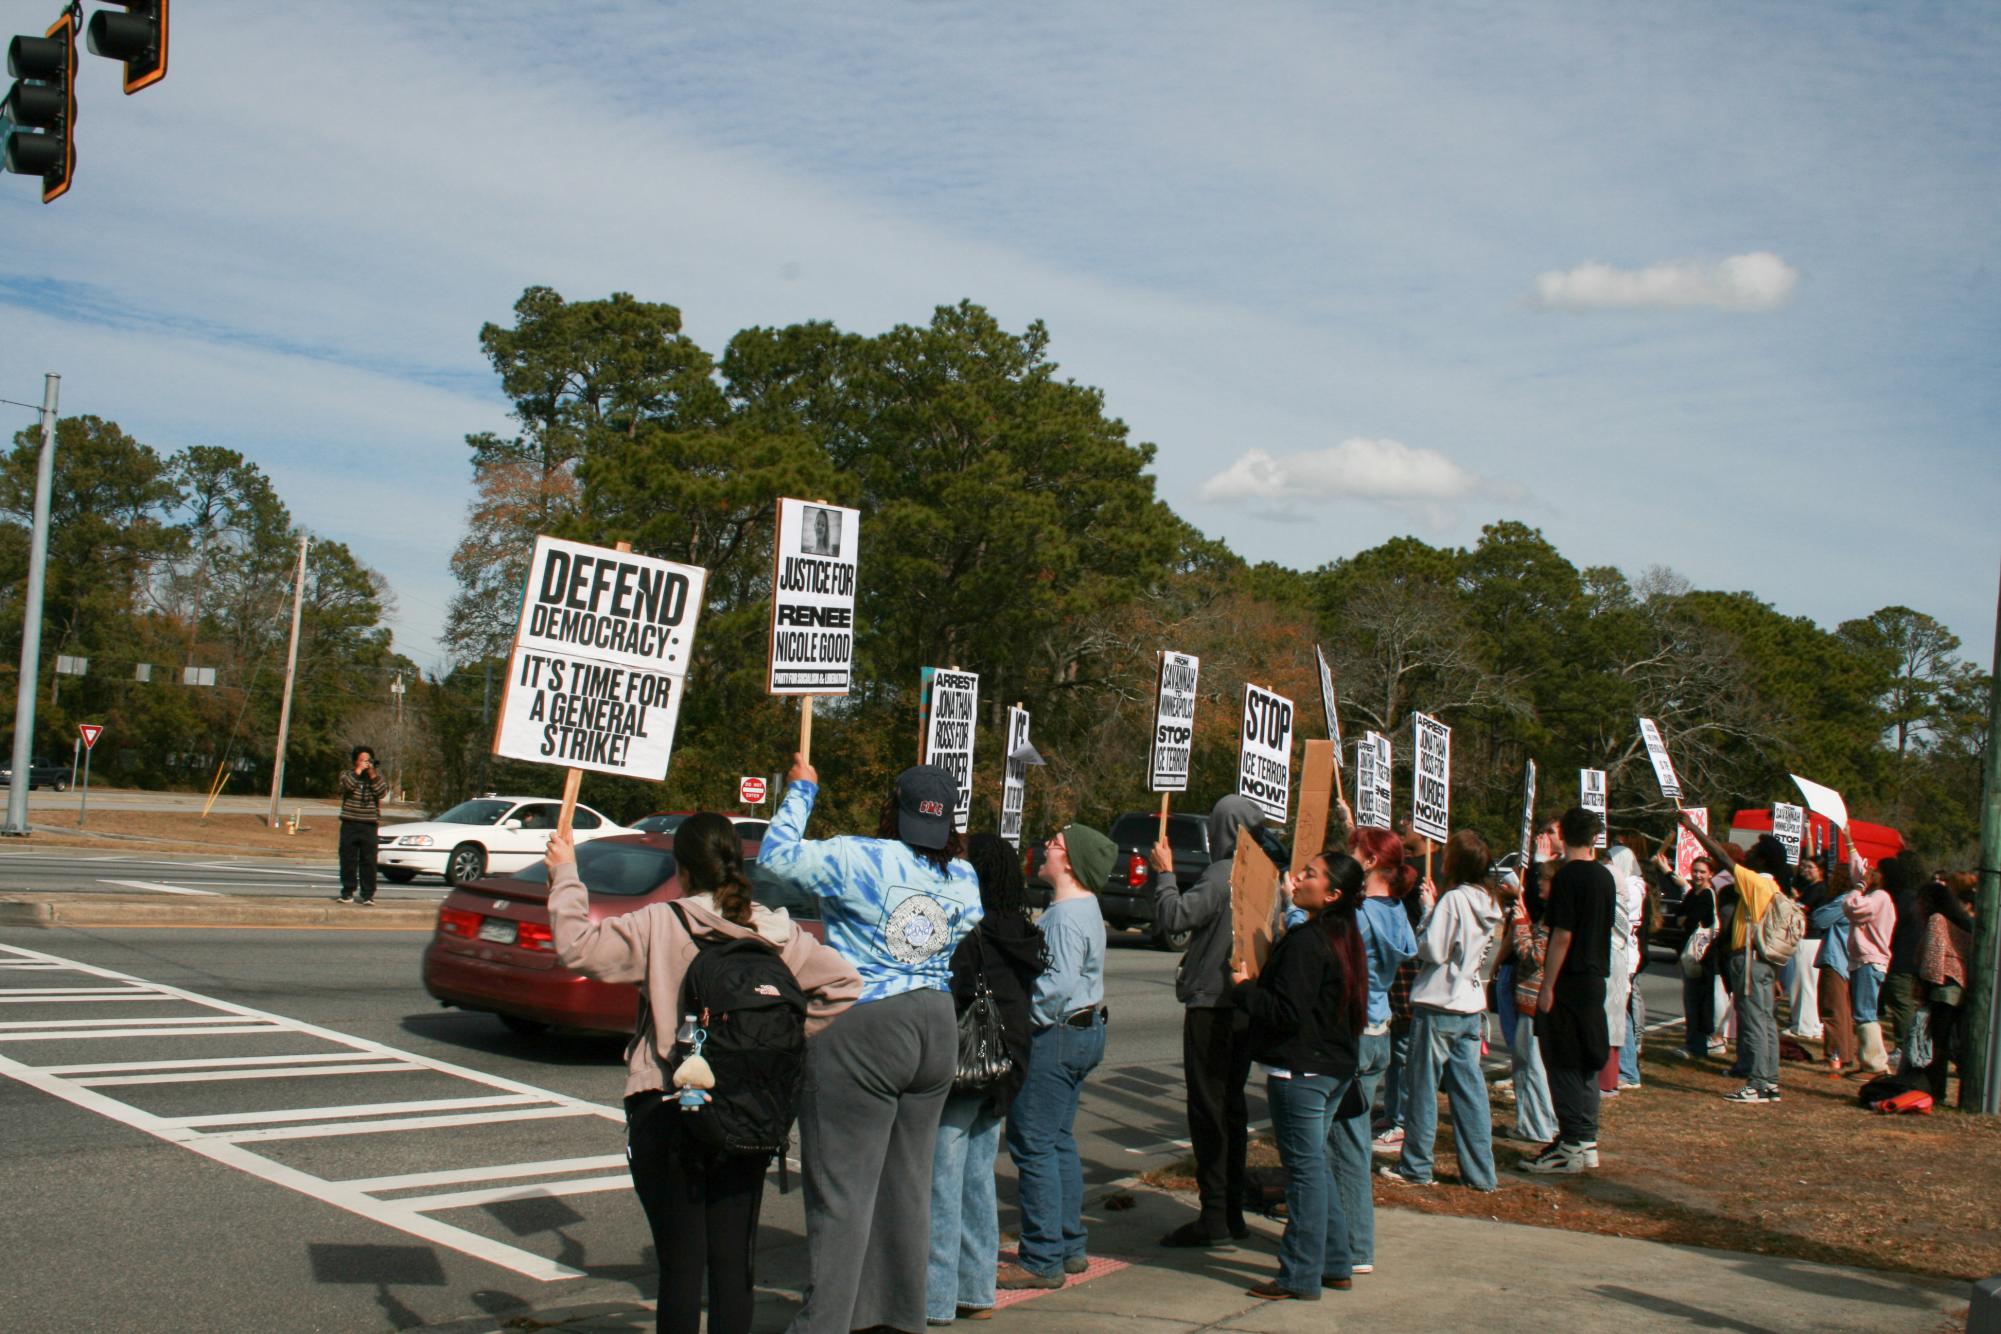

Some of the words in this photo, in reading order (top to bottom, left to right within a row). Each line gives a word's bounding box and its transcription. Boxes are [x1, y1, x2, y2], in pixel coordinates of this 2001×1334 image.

[539, 549, 689, 626] DEFEND
[780, 557, 831, 594] JUSTICE
[831, 563, 854, 596] FOR
[778, 604, 851, 628] RENEE
[529, 604, 679, 661] DEMOCRACY:
[776, 631, 818, 662] NICOLE
[819, 633, 850, 663] GOOD
[520, 654, 566, 692] IT'S
[570, 662, 624, 702] TIME
[625, 672, 672, 709] FOR
[774, 673, 788, 685] PARTY
[788, 673, 798, 685] FOR
[819, 673, 824, 685] &
[936, 673, 976, 691] ARREST
[1163, 664, 1195, 693] SAVANNAH
[529, 690, 545, 722] A
[549, 693, 648, 738] GENERAL
[936, 690, 973, 720] JONATHAN
[1161, 695, 1193, 719] MINNEAPOLIS
[935, 720, 955, 749] ROSS
[955, 721, 969, 749] FOR
[1158, 725, 1190, 744] STOP
[1246, 689, 1291, 752] STOP
[1417, 716, 1448, 738] ARREST
[540, 724, 631, 767] STRIKE!
[1156, 746, 1166, 771] ICE
[1166, 747, 1188, 772] TERROR
[1420, 730, 1445, 759] JONATHAN
[1243, 750, 1256, 776] ICE
[1257, 756, 1287, 787] TERROR
[1420, 750, 1433, 775] ROSS
[1434, 756, 1444, 779] FOR
[1241, 776, 1286, 805] NOW!
[1419, 774, 1445, 809] MURDER
[1357, 811, 1375, 825] NOW!
[1416, 801, 1447, 825] NOW!
[1776, 808, 1800, 822] SAVANNAH
[1775, 834, 1799, 844] STOP
